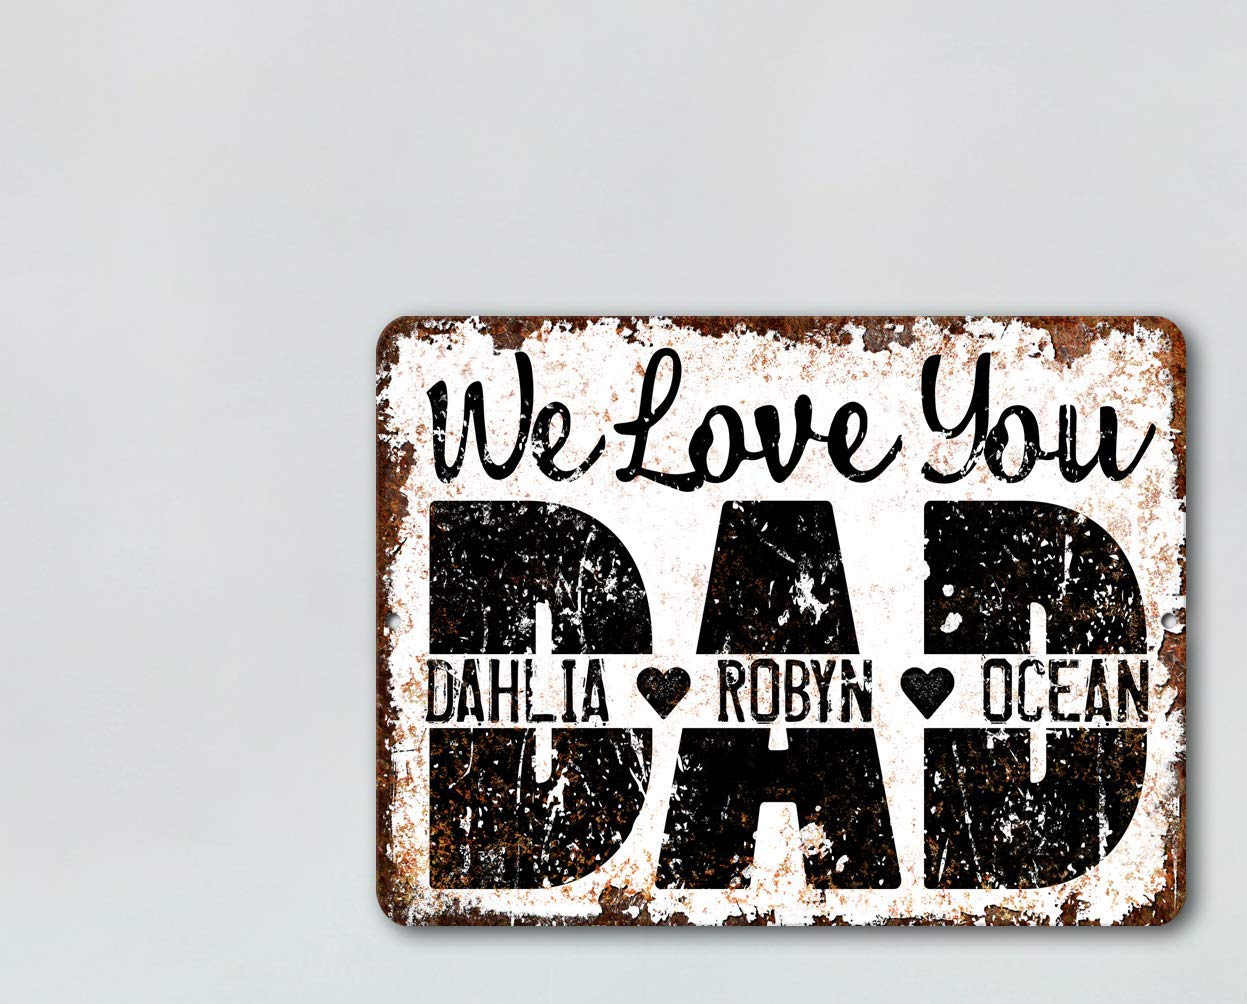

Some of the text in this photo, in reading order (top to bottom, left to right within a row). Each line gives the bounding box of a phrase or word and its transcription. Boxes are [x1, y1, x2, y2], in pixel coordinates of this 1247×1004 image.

[427, 347, 1157, 492] We Love You
[426, 658, 609, 724] DAHLIA
[429, 500, 1149, 890] DAD
[717, 658, 873, 723] ROBYN
[981, 658, 1149, 723] OCEAN
